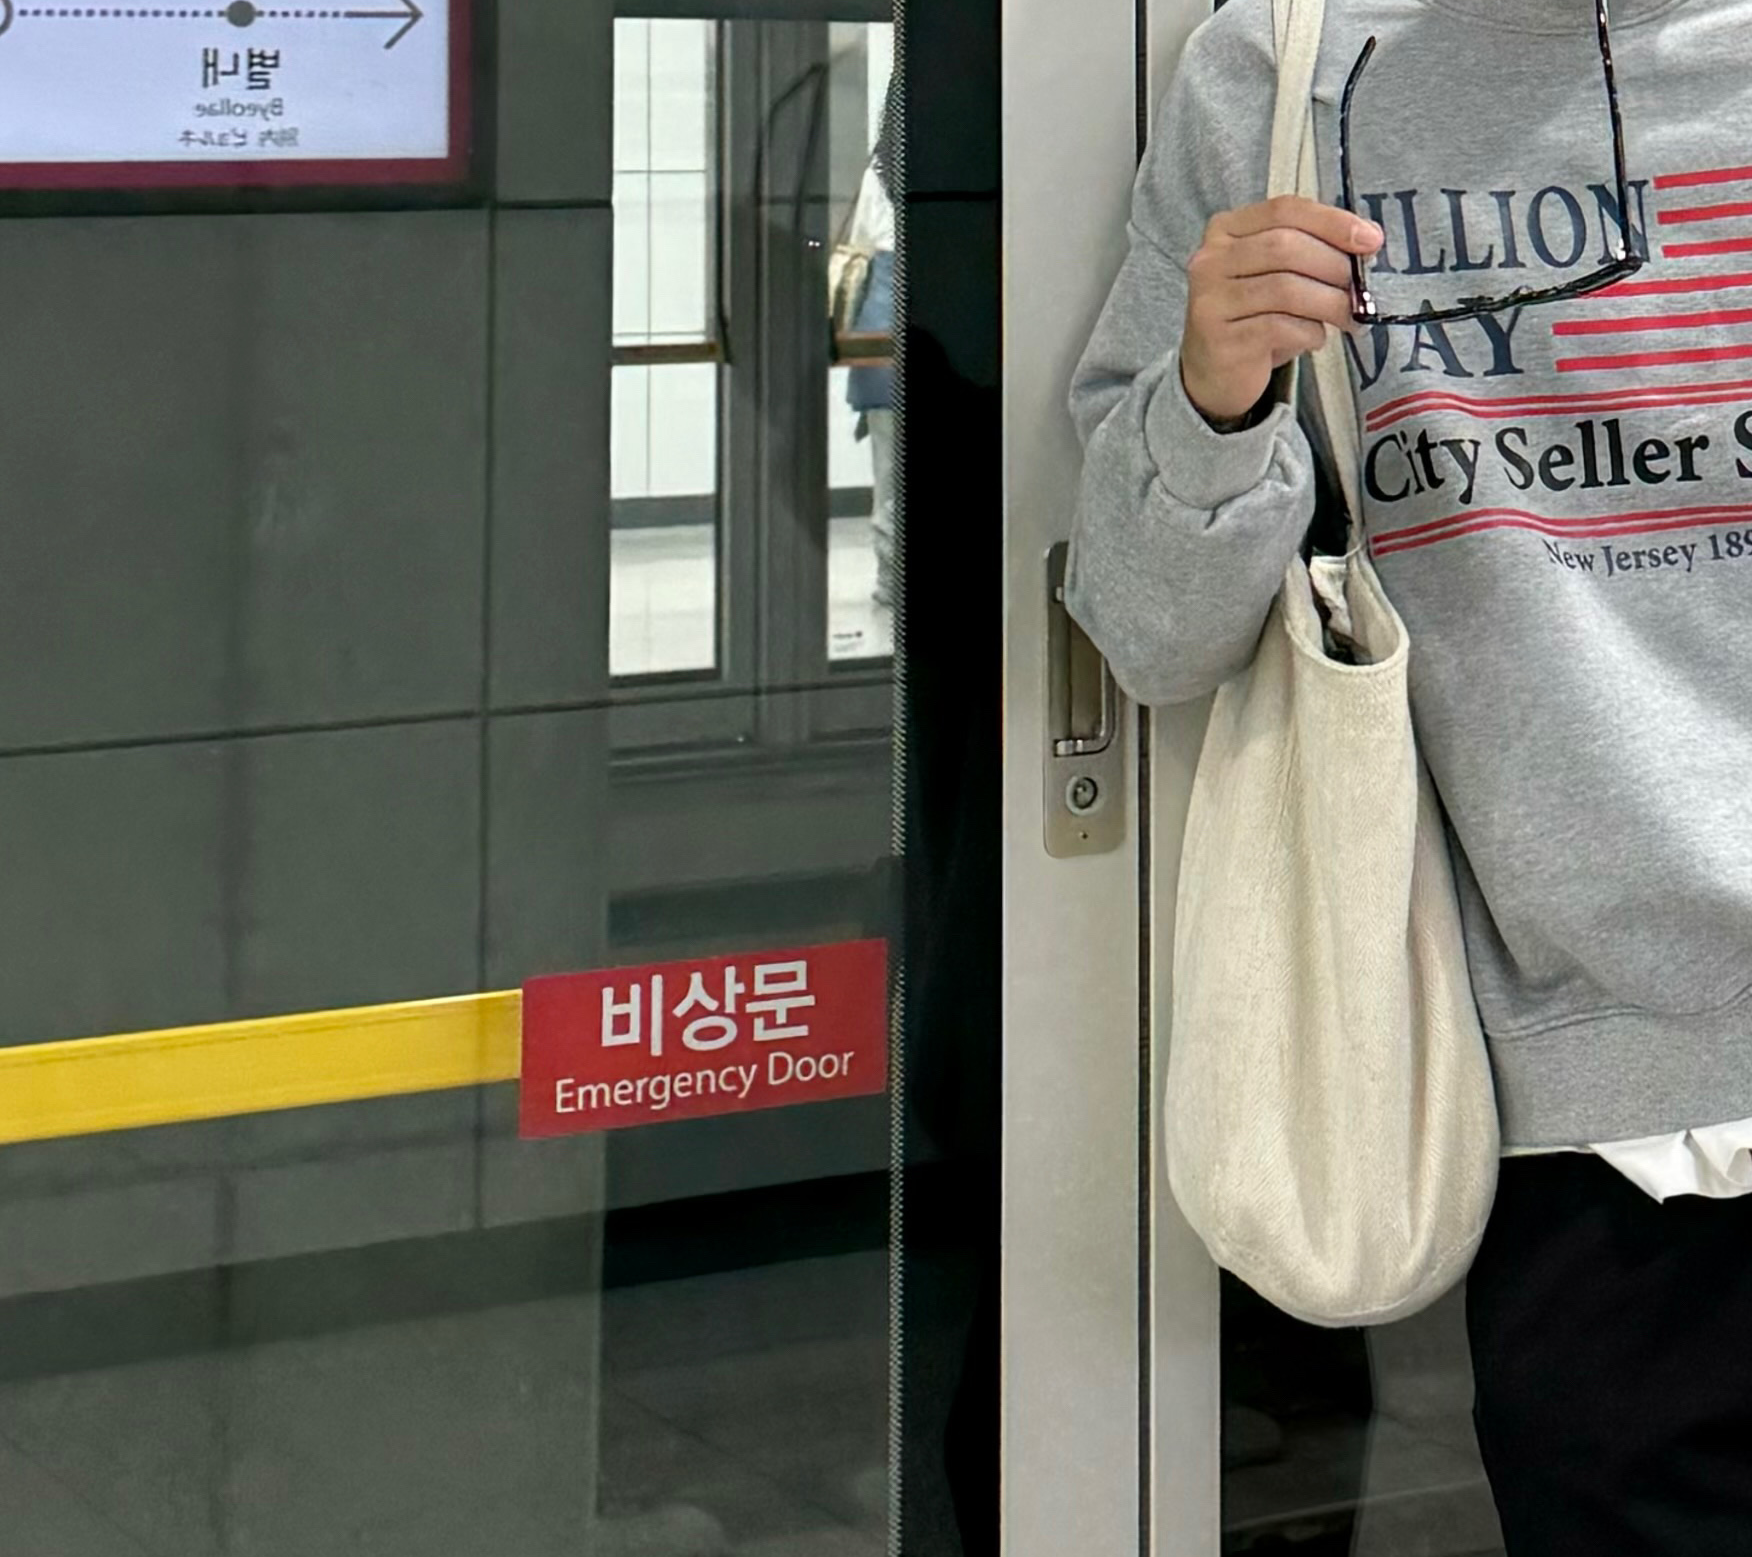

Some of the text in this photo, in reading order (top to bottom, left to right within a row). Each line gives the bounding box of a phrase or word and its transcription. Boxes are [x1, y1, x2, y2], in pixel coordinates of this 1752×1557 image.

[1336, 180, 1650, 276] ILLION
[1364, 426, 1488, 505] City
[1497, 419, 1709, 491] Seller
[1543, 538, 1595, 573] New
[1600, 540, 1697, 577] Jersey
[601, 960, 815, 1057] 비상문
[555, 1050, 855, 1114] Emergency Door
